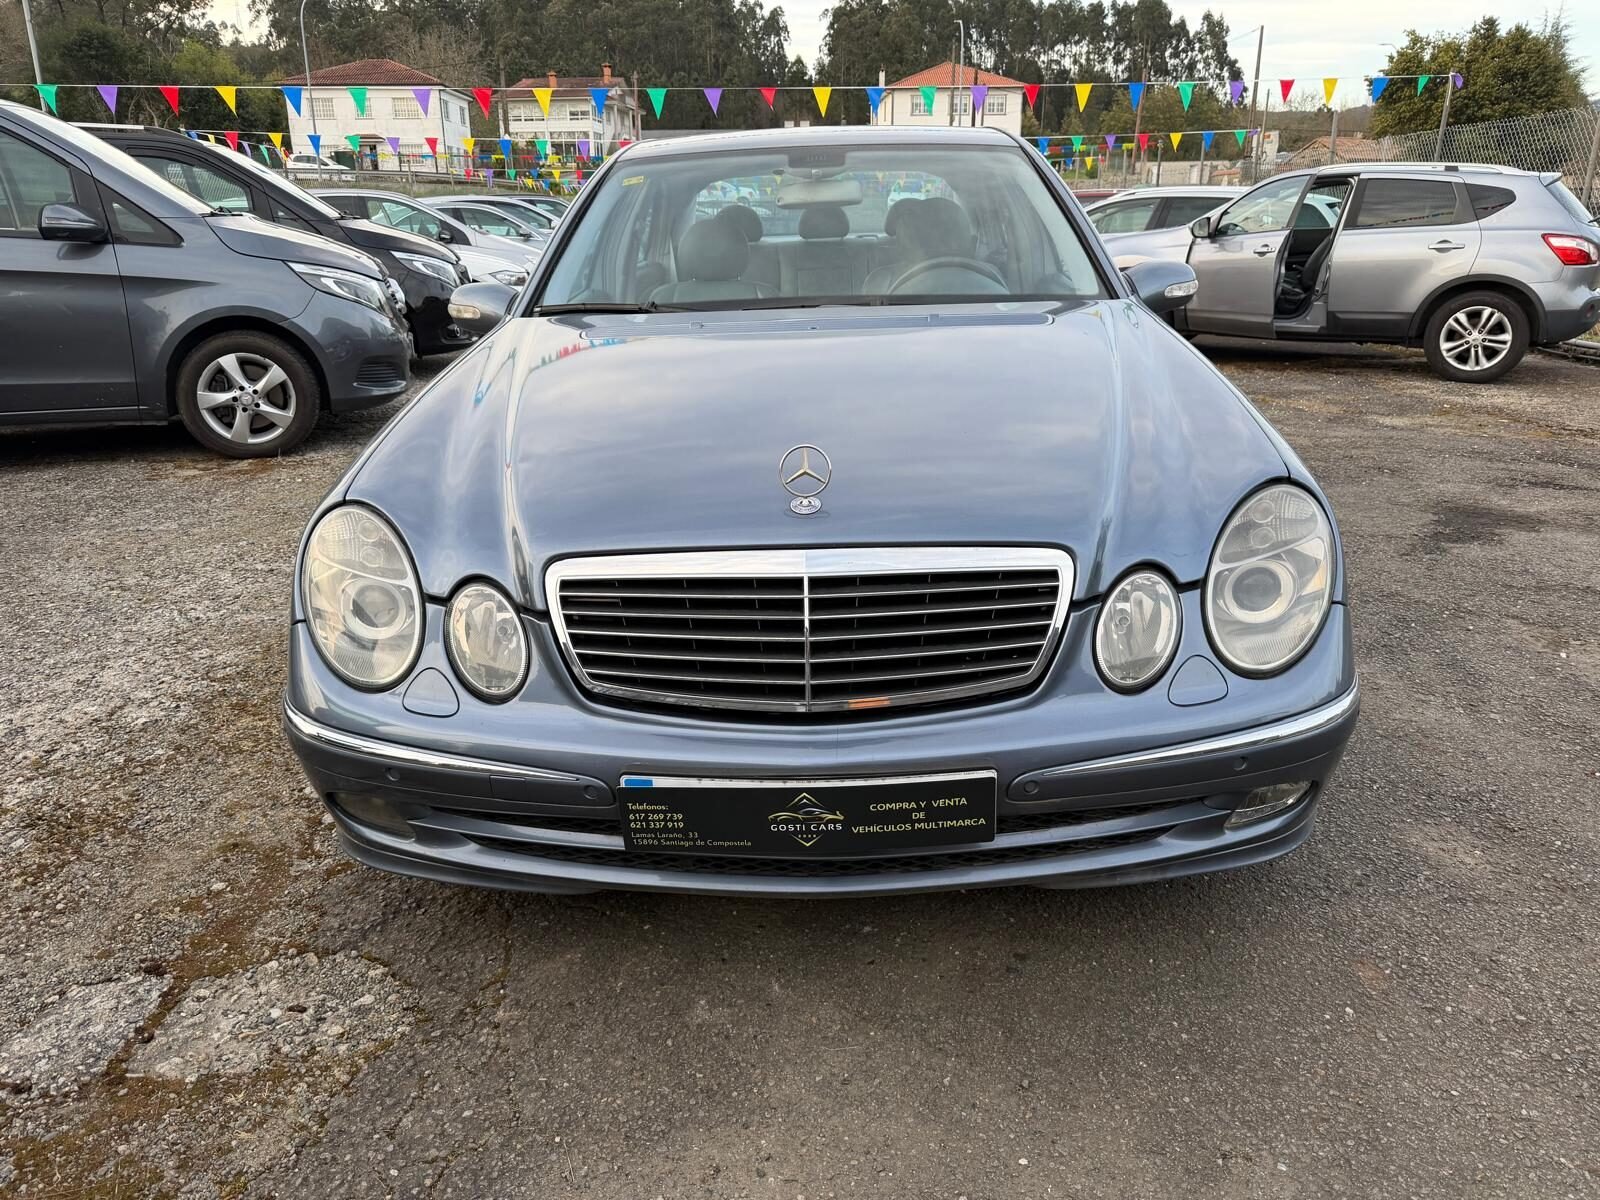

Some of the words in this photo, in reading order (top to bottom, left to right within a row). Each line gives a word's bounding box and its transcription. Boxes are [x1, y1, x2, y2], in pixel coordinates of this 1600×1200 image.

[869, 802, 917, 811] COMPRA
[920, 801, 927, 809] Y
[931, 797, 968, 807] VENTA
[912, 812, 926, 820] DE
[630, 821, 646, 829] 621
[649, 821, 665, 829] 337
[667, 821, 684, 829] 919
[810, 823, 843, 831] CARS
[851, 823, 912, 834] VEHÍCULOS
[914, 818, 987, 830] MULTIMARCA
[661, 839, 694, 847] Santiago
[706, 839, 752, 847] Compostela
